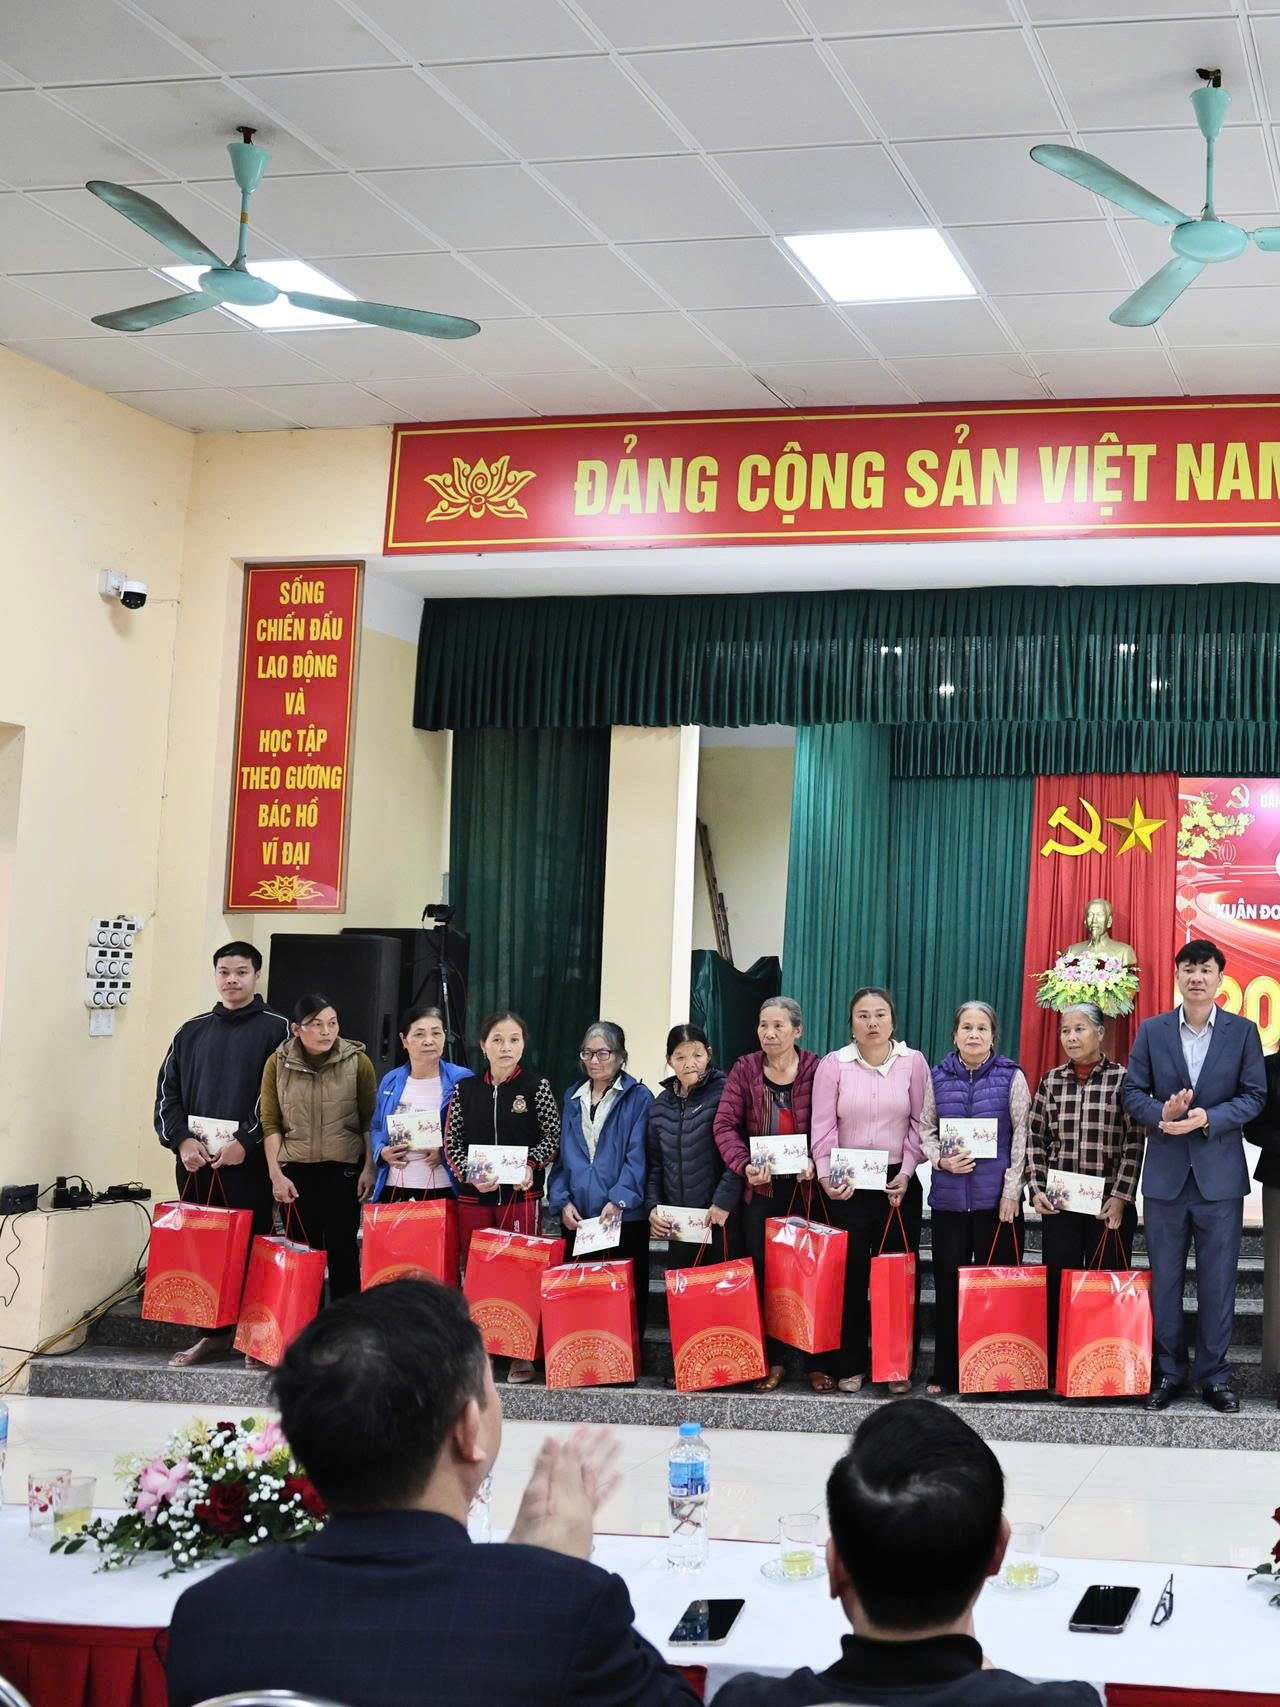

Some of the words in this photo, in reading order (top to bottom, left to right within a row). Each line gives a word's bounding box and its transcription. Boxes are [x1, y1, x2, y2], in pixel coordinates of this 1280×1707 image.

[573, 433, 718, 516] ĐẢNG
[737, 441, 885, 524] CỘNG
[904, 423, 1019, 507] SẢN
[1039, 431, 1157, 516] VIỆT
[280, 575, 324, 604] SỐNG
[257, 611, 304, 641] CHIẾN
[310, 611, 342, 641] ĐẤU
[258, 655, 288, 679] LAO
[293, 650, 337, 682] ĐỘNG
[285, 688, 305, 715] VÀ
[259, 729, 291, 757] HỌC
[297, 724, 327, 757] TẬP
[242, 766, 281, 790] THEO
[285, 764, 342, 789] GƯƠNG
[258, 797, 290, 827] BÁC
[296, 795, 319, 827] HỒ
[262, 837, 279, 865] VĨ
[282, 842, 310, 870] ĐẠI
